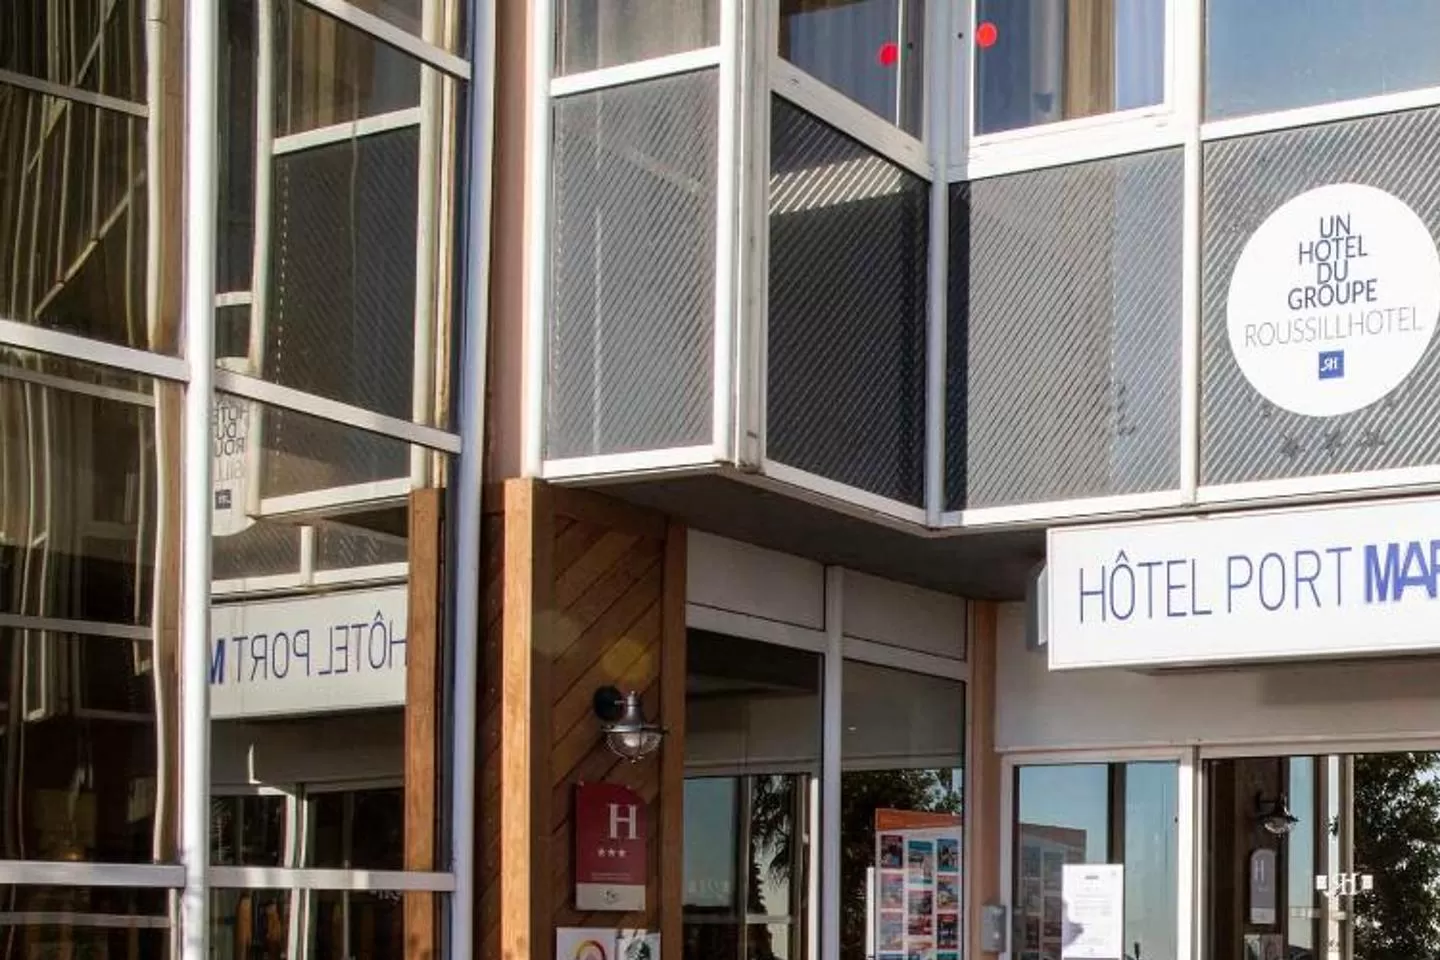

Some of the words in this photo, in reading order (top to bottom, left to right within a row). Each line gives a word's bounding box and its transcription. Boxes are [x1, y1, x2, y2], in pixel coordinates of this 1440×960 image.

[1320, 212, 1351, 238] UN
[1298, 235, 1368, 265] HOTEL
[1317, 259, 1349, 285] DU
[1287, 278, 1378, 311] GROUPE
[1244, 306, 1425, 348] ROUSSILLHOTEL
[1079, 549, 1213, 624] HÔTEL
[1227, 546, 1353, 614] PORT
[608, 803, 638, 840] H
